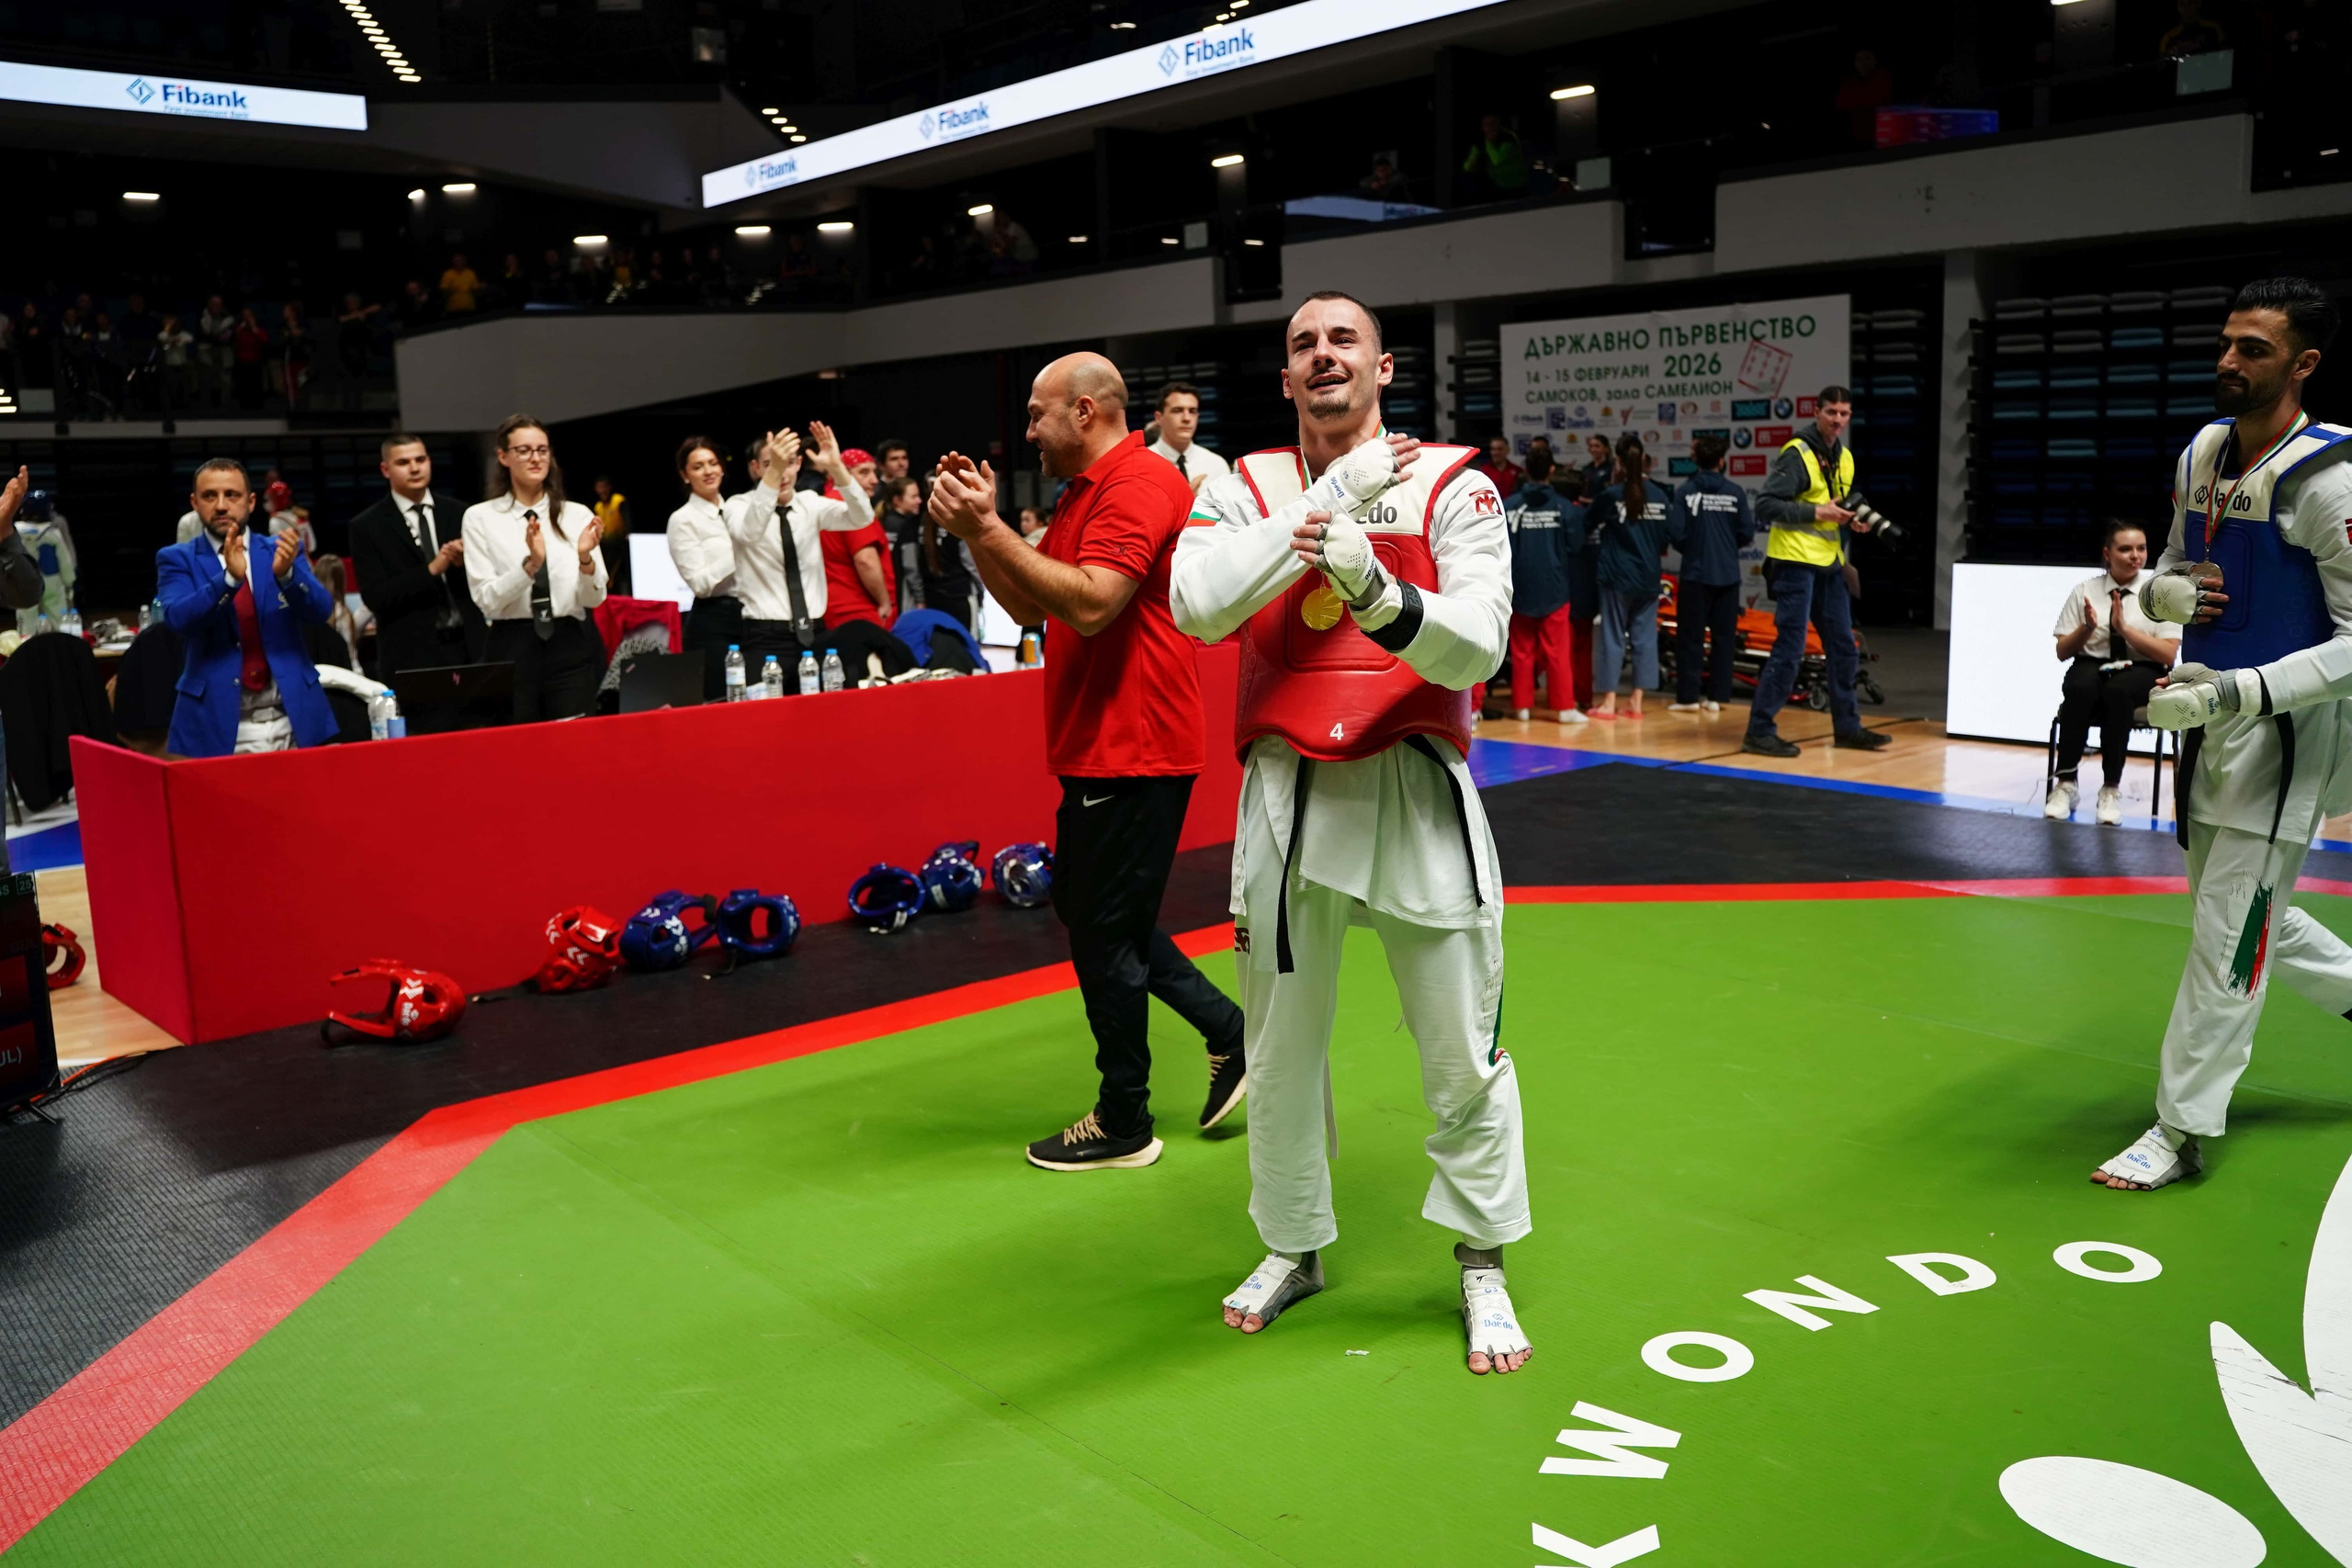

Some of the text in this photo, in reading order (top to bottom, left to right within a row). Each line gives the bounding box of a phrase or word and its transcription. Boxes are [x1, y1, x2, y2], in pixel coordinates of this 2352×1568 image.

[1185, 28, 1254, 65] Fibank
[162, 84, 247, 108] Fibank
[939, 101, 989, 130] Fibank
[1524, 314, 1816, 360] ДЪРЖАВНО ПЪРВЕНСТВО
[1526, 370, 1541, 384] 14
[1555, 368, 1570, 382] 15
[1574, 365, 1650, 382] ФЕВРУАРИ
[1664, 352, 1722, 378] 2026
[1525, 388, 1601, 404] САМОКОВ,
[1644, 380, 1733, 399] САМЕЛИОН
[1329, 722, 1344, 741] 4
[2126, 1152, 2152, 1169] Daedo
